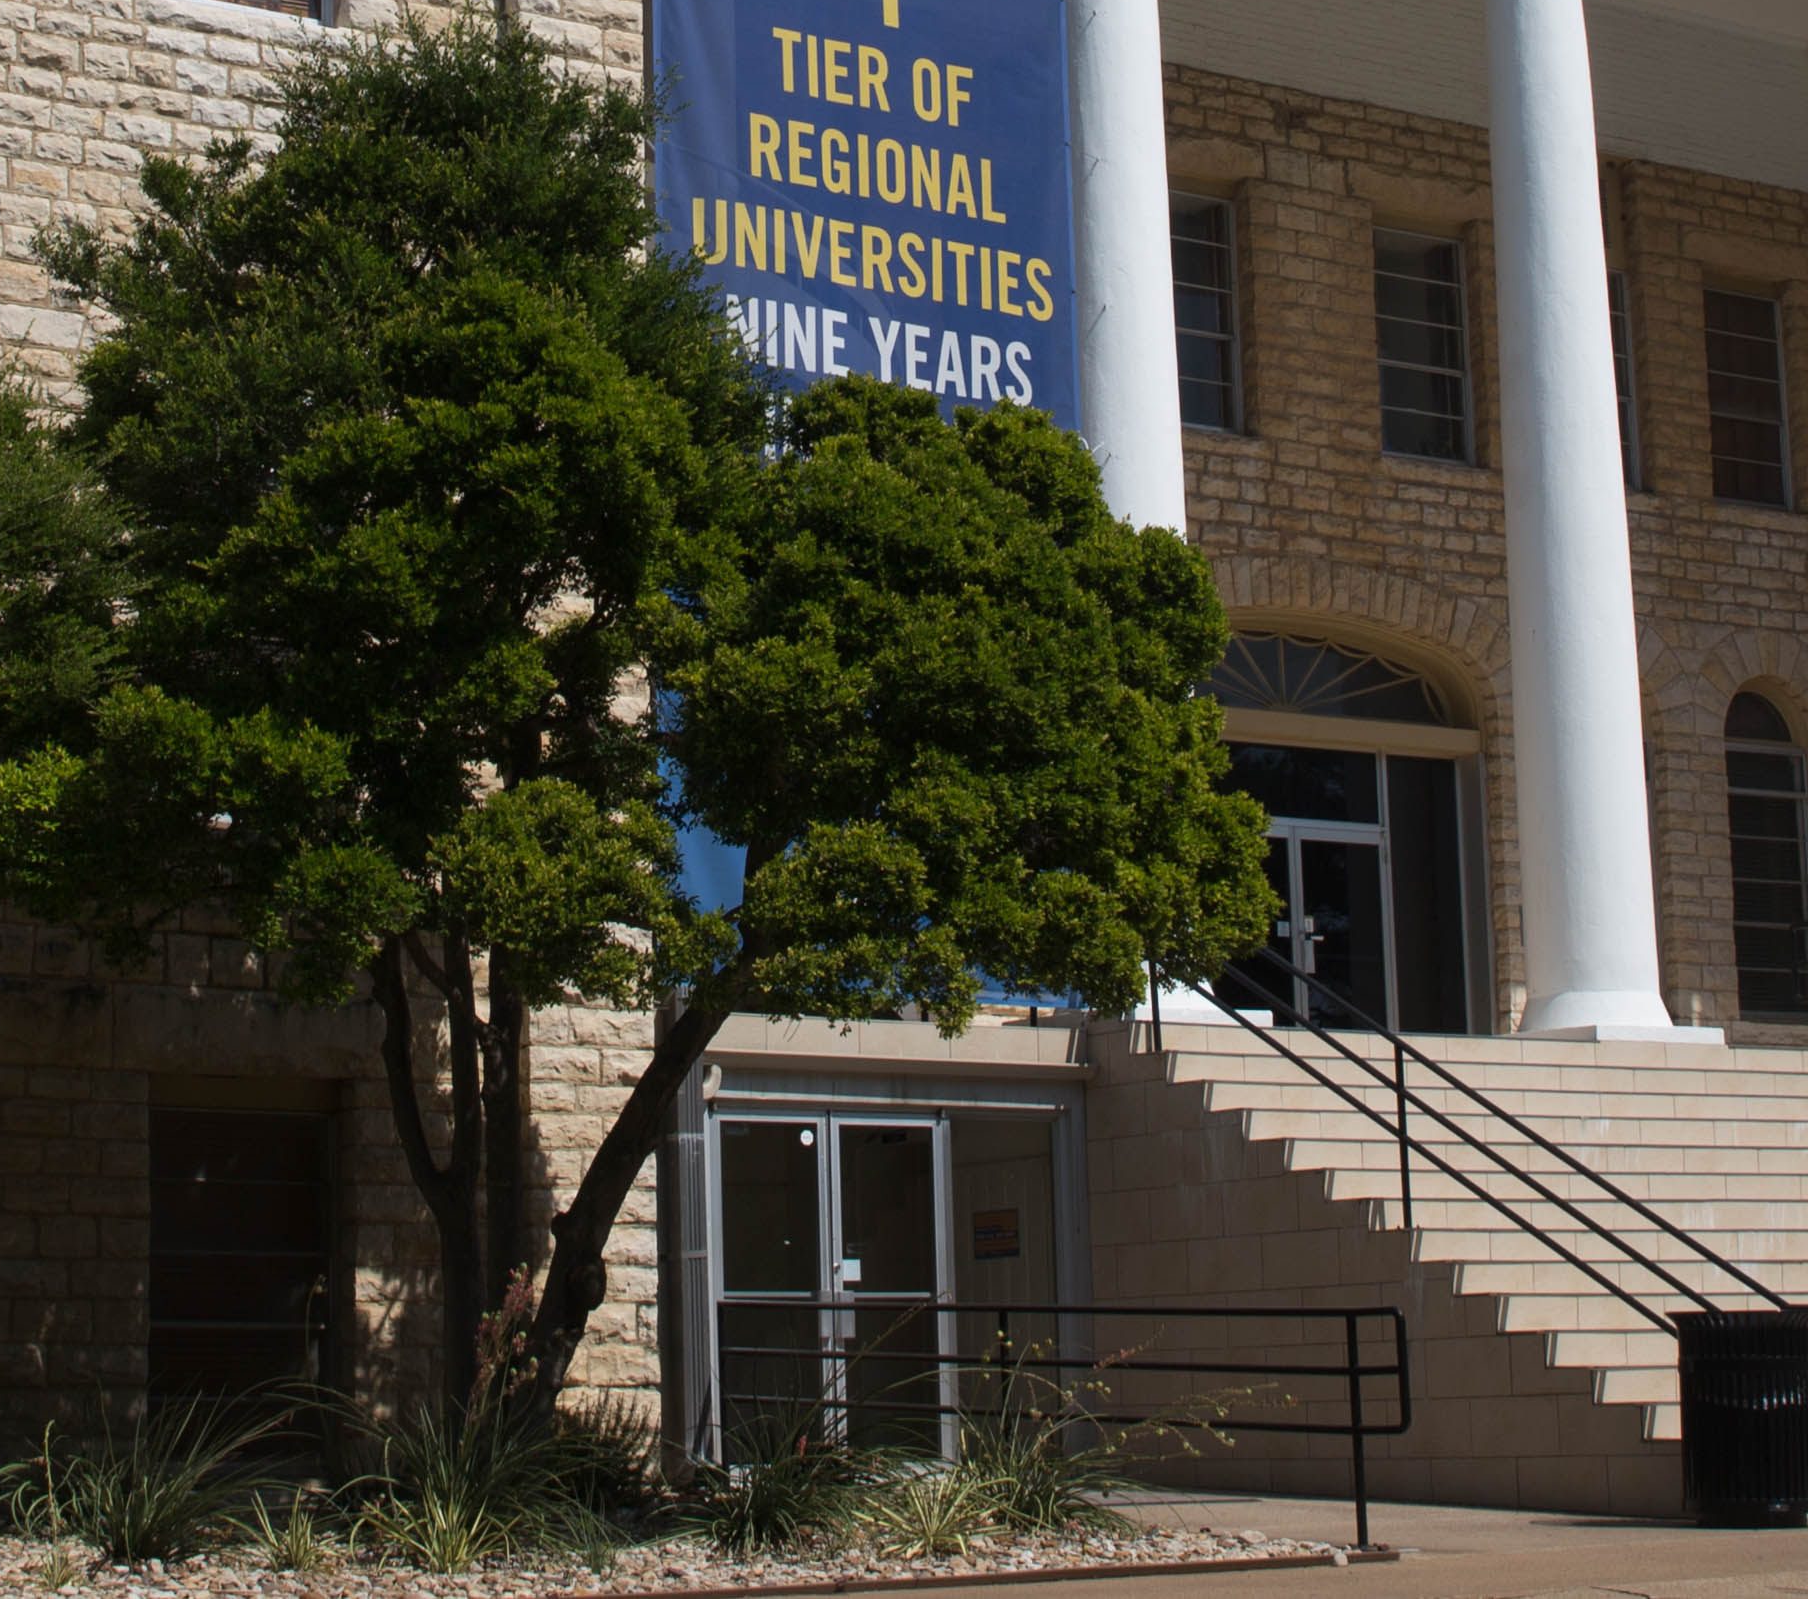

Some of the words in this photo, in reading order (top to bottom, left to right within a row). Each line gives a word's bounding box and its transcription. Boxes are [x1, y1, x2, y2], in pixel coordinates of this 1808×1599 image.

[772, 26, 891, 113] TIER
[912, 58, 974, 127] OF
[749, 112, 1007, 224] REGIONAL
[692, 197, 1055, 322] UNIVERSITIES
[725, 293, 851, 378] NINE
[867, 316, 1034, 406] YEARS
